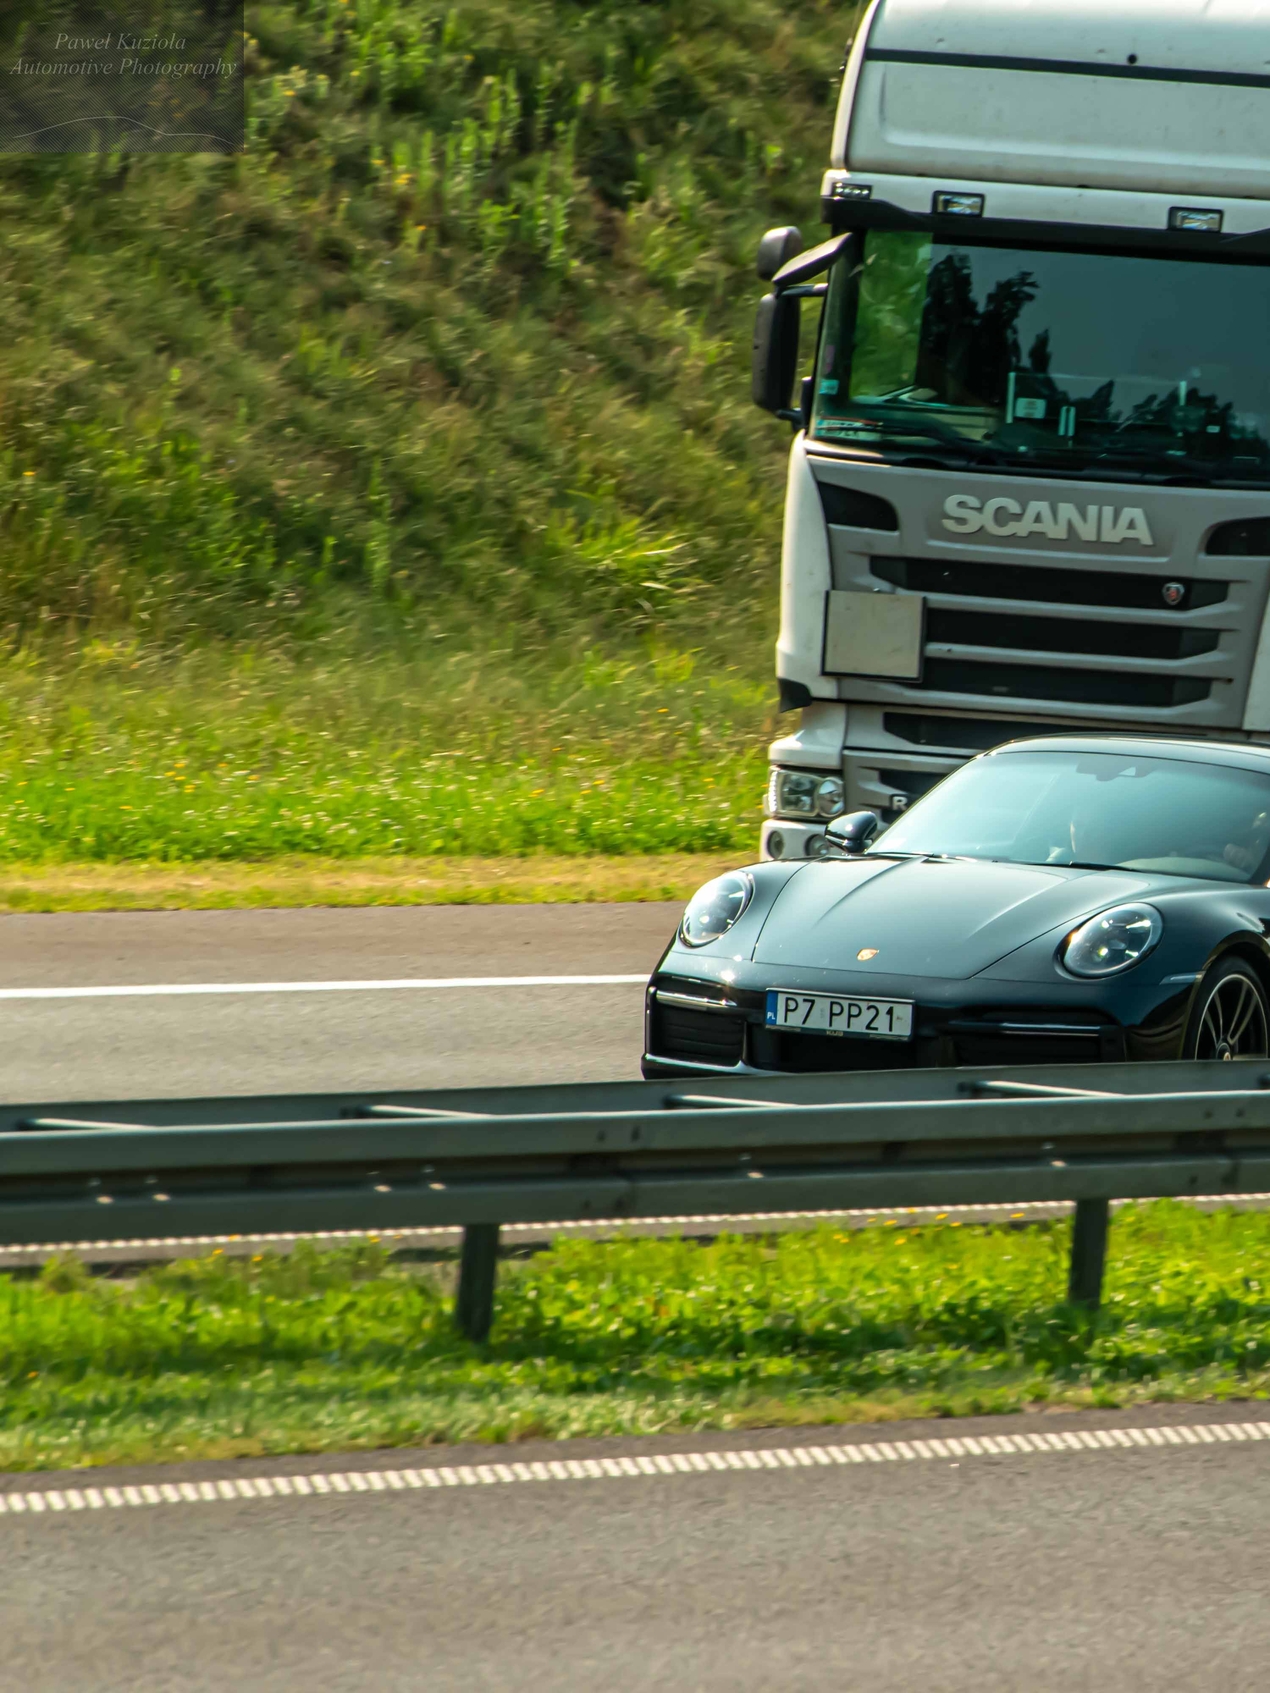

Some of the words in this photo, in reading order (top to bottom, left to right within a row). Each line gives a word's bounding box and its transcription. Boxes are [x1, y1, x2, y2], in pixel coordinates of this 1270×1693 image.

[941, 494, 1154, 546] SCANIA
[892, 796, 908, 811] R
[767, 1012, 776, 1020] PL
[784, 997, 815, 1025] P7
[829, 1001, 894, 1032] PP21
